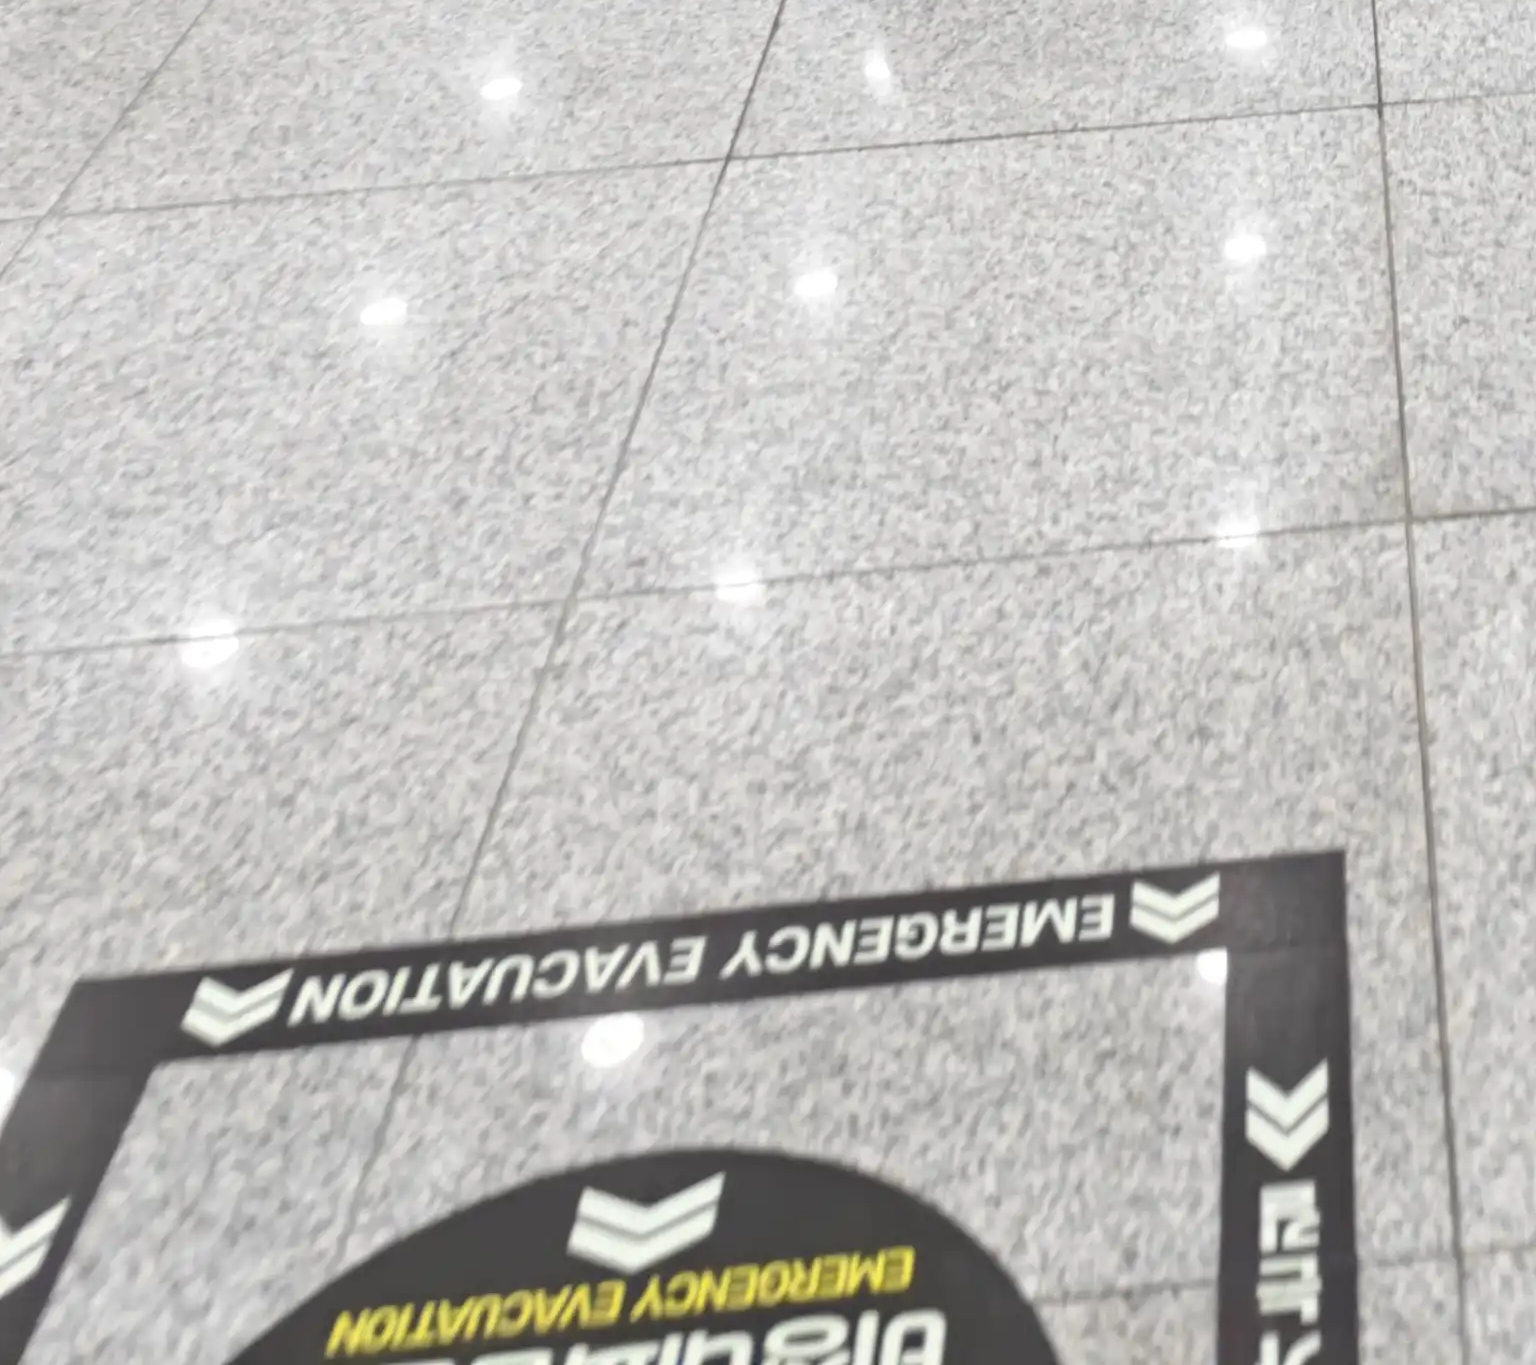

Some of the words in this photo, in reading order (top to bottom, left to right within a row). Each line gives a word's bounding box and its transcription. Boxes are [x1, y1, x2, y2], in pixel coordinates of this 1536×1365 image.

[721, 891, 1116, 979] EMERGENCY
[287, 934, 706, 1026] EVACUATION
[326, 1278, 626, 1359] EVACUATION
[631, 1245, 916, 1319] EMERGENCY
